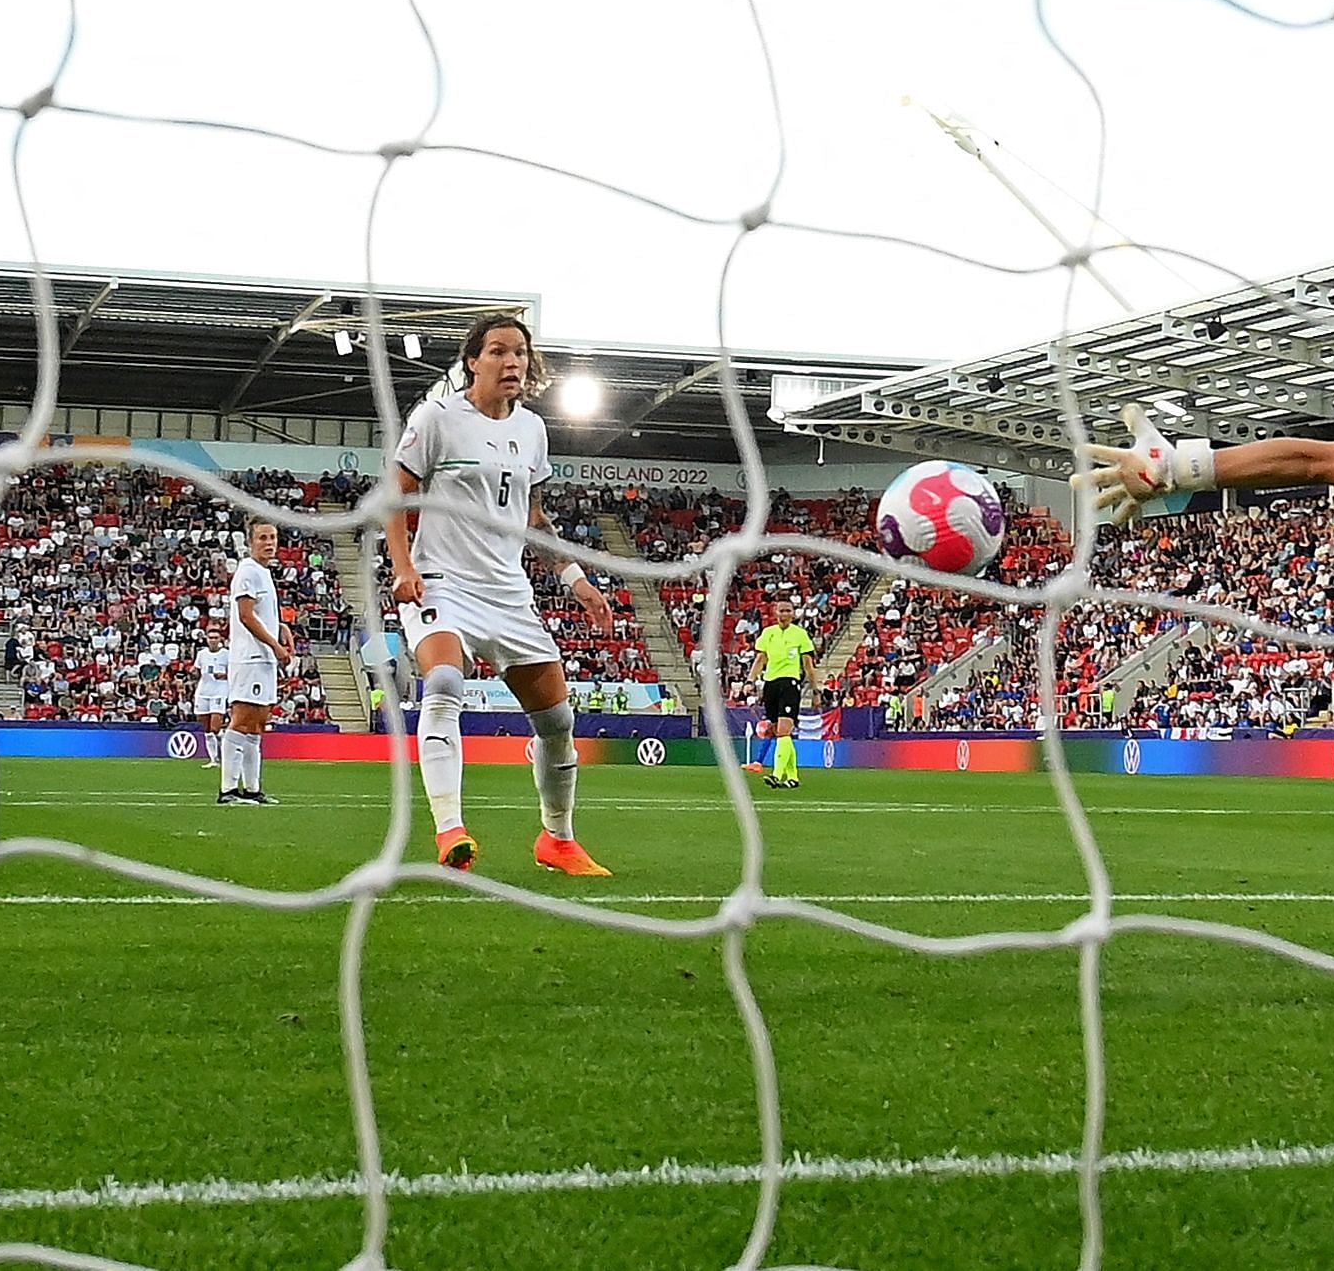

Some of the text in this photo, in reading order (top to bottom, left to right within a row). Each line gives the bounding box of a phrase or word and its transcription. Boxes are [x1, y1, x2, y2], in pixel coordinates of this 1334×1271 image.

[580, 464, 664, 483] ENGLAND
[669, 468, 708, 485] 2022
[498, 471, 513, 508] 5
